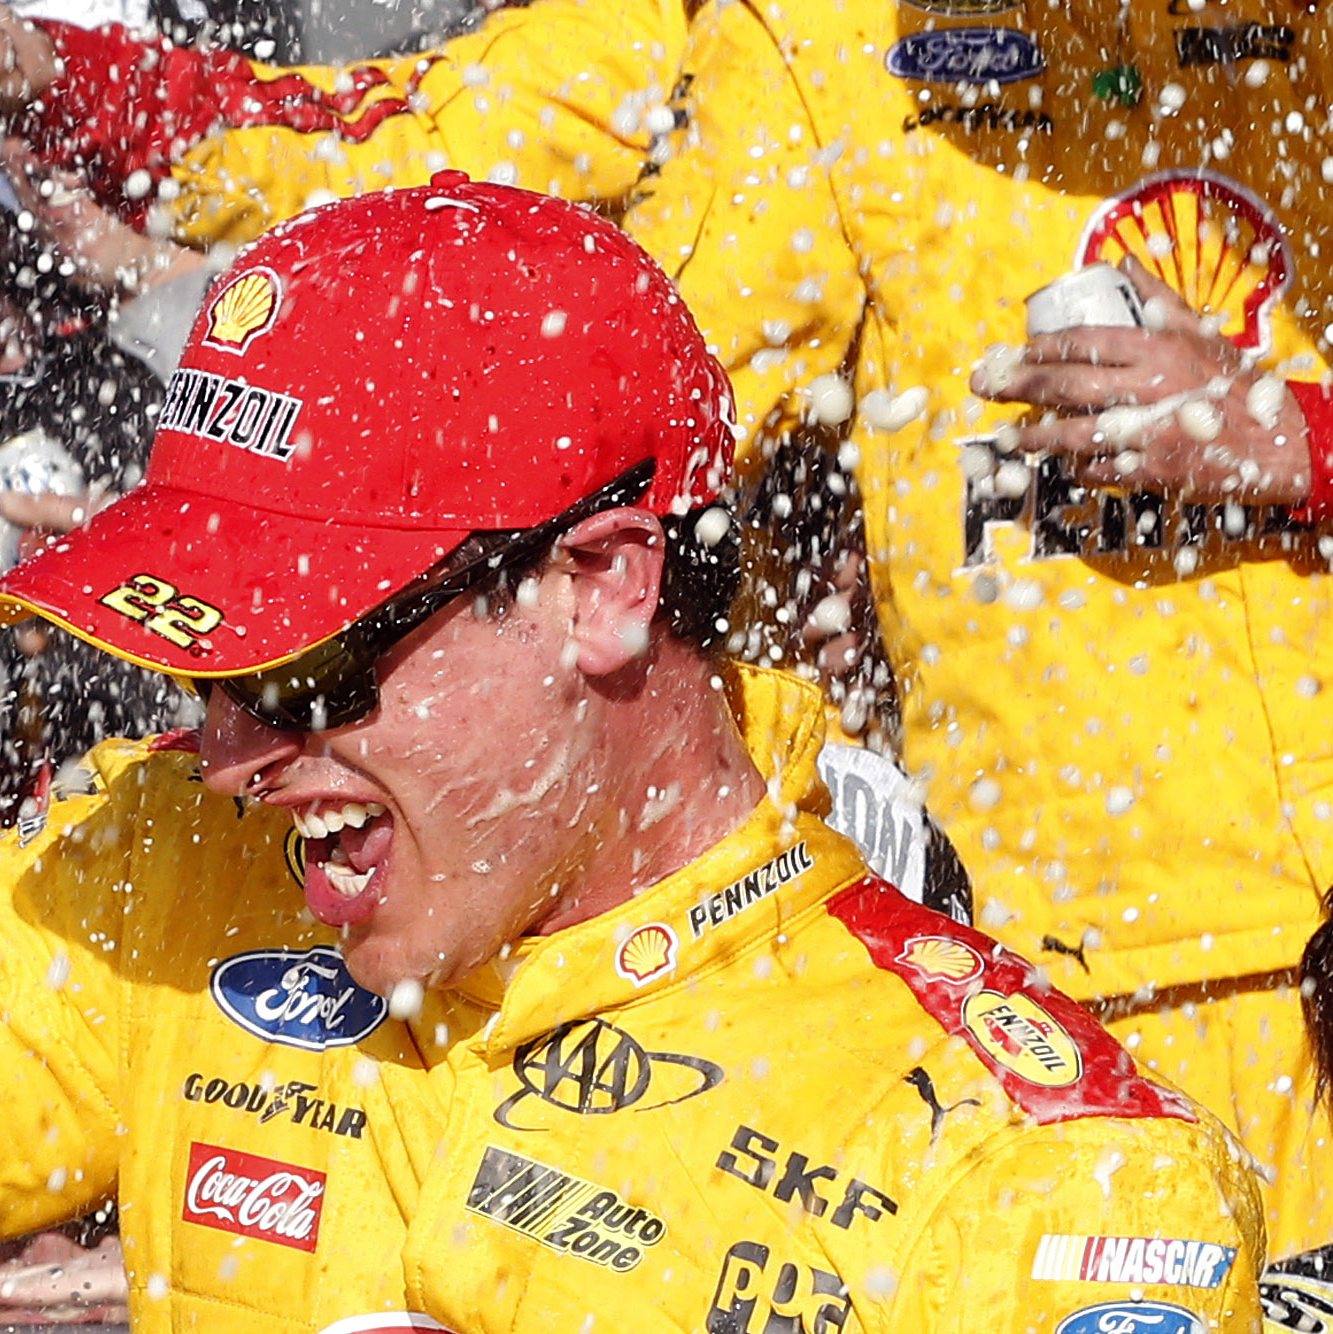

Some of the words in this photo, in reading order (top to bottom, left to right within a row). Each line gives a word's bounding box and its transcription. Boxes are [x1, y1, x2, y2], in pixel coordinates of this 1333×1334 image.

[156, 368, 303, 462] ENNZOIL
[99, 573, 224, 649] 22
[686, 840, 816, 939] PENNZOIL
[254, 961, 355, 1031] Ford
[978, 1005, 1067, 1072] ENZOIL
[184, 1072, 367, 1139] GOODYEAR
[186, 1156, 325, 1240] Coca-Cola
[715, 1125, 898, 1230] SKF
[545, 1217, 641, 1271] Zone
[578, 1190, 665, 1242] Auto
[1096, 1237, 1223, 1288] NASCAR
